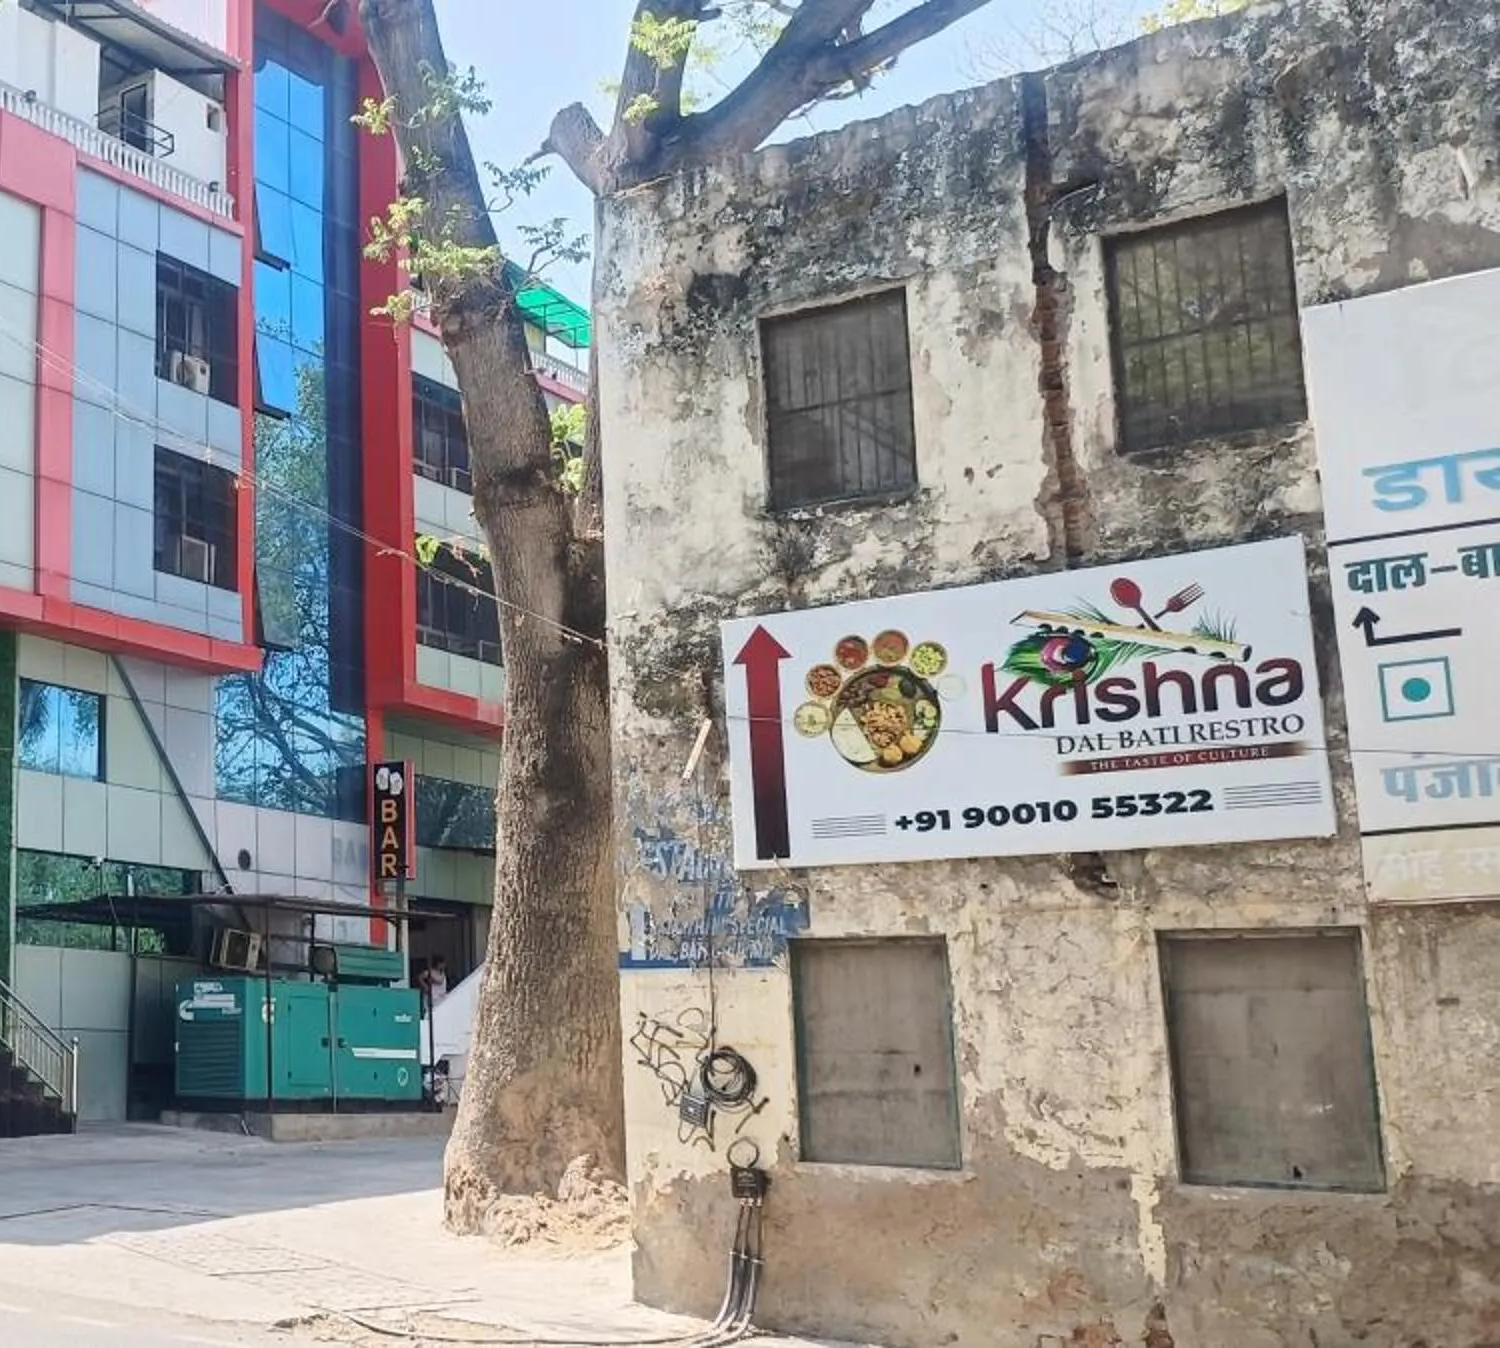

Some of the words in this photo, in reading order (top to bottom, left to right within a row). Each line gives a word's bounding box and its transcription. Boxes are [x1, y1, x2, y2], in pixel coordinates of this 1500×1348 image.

[1056, 733, 1112, 755] DAL
[1118, 724, 1179, 750] BATI
[1189, 713, 1305, 743] RESTRO
[1089, 760, 1120, 772] THE
[1124, 757, 1167, 769] TASTE
[1172, 752, 1193, 765] OF
[1197, 747, 1270, 763] CULTURE
[895, 809, 951, 832] +91
[961, 799, 1079, 828] 90010
[1090, 789, 1215, 818] 55322
[381, 799, 399, 877] BAR
